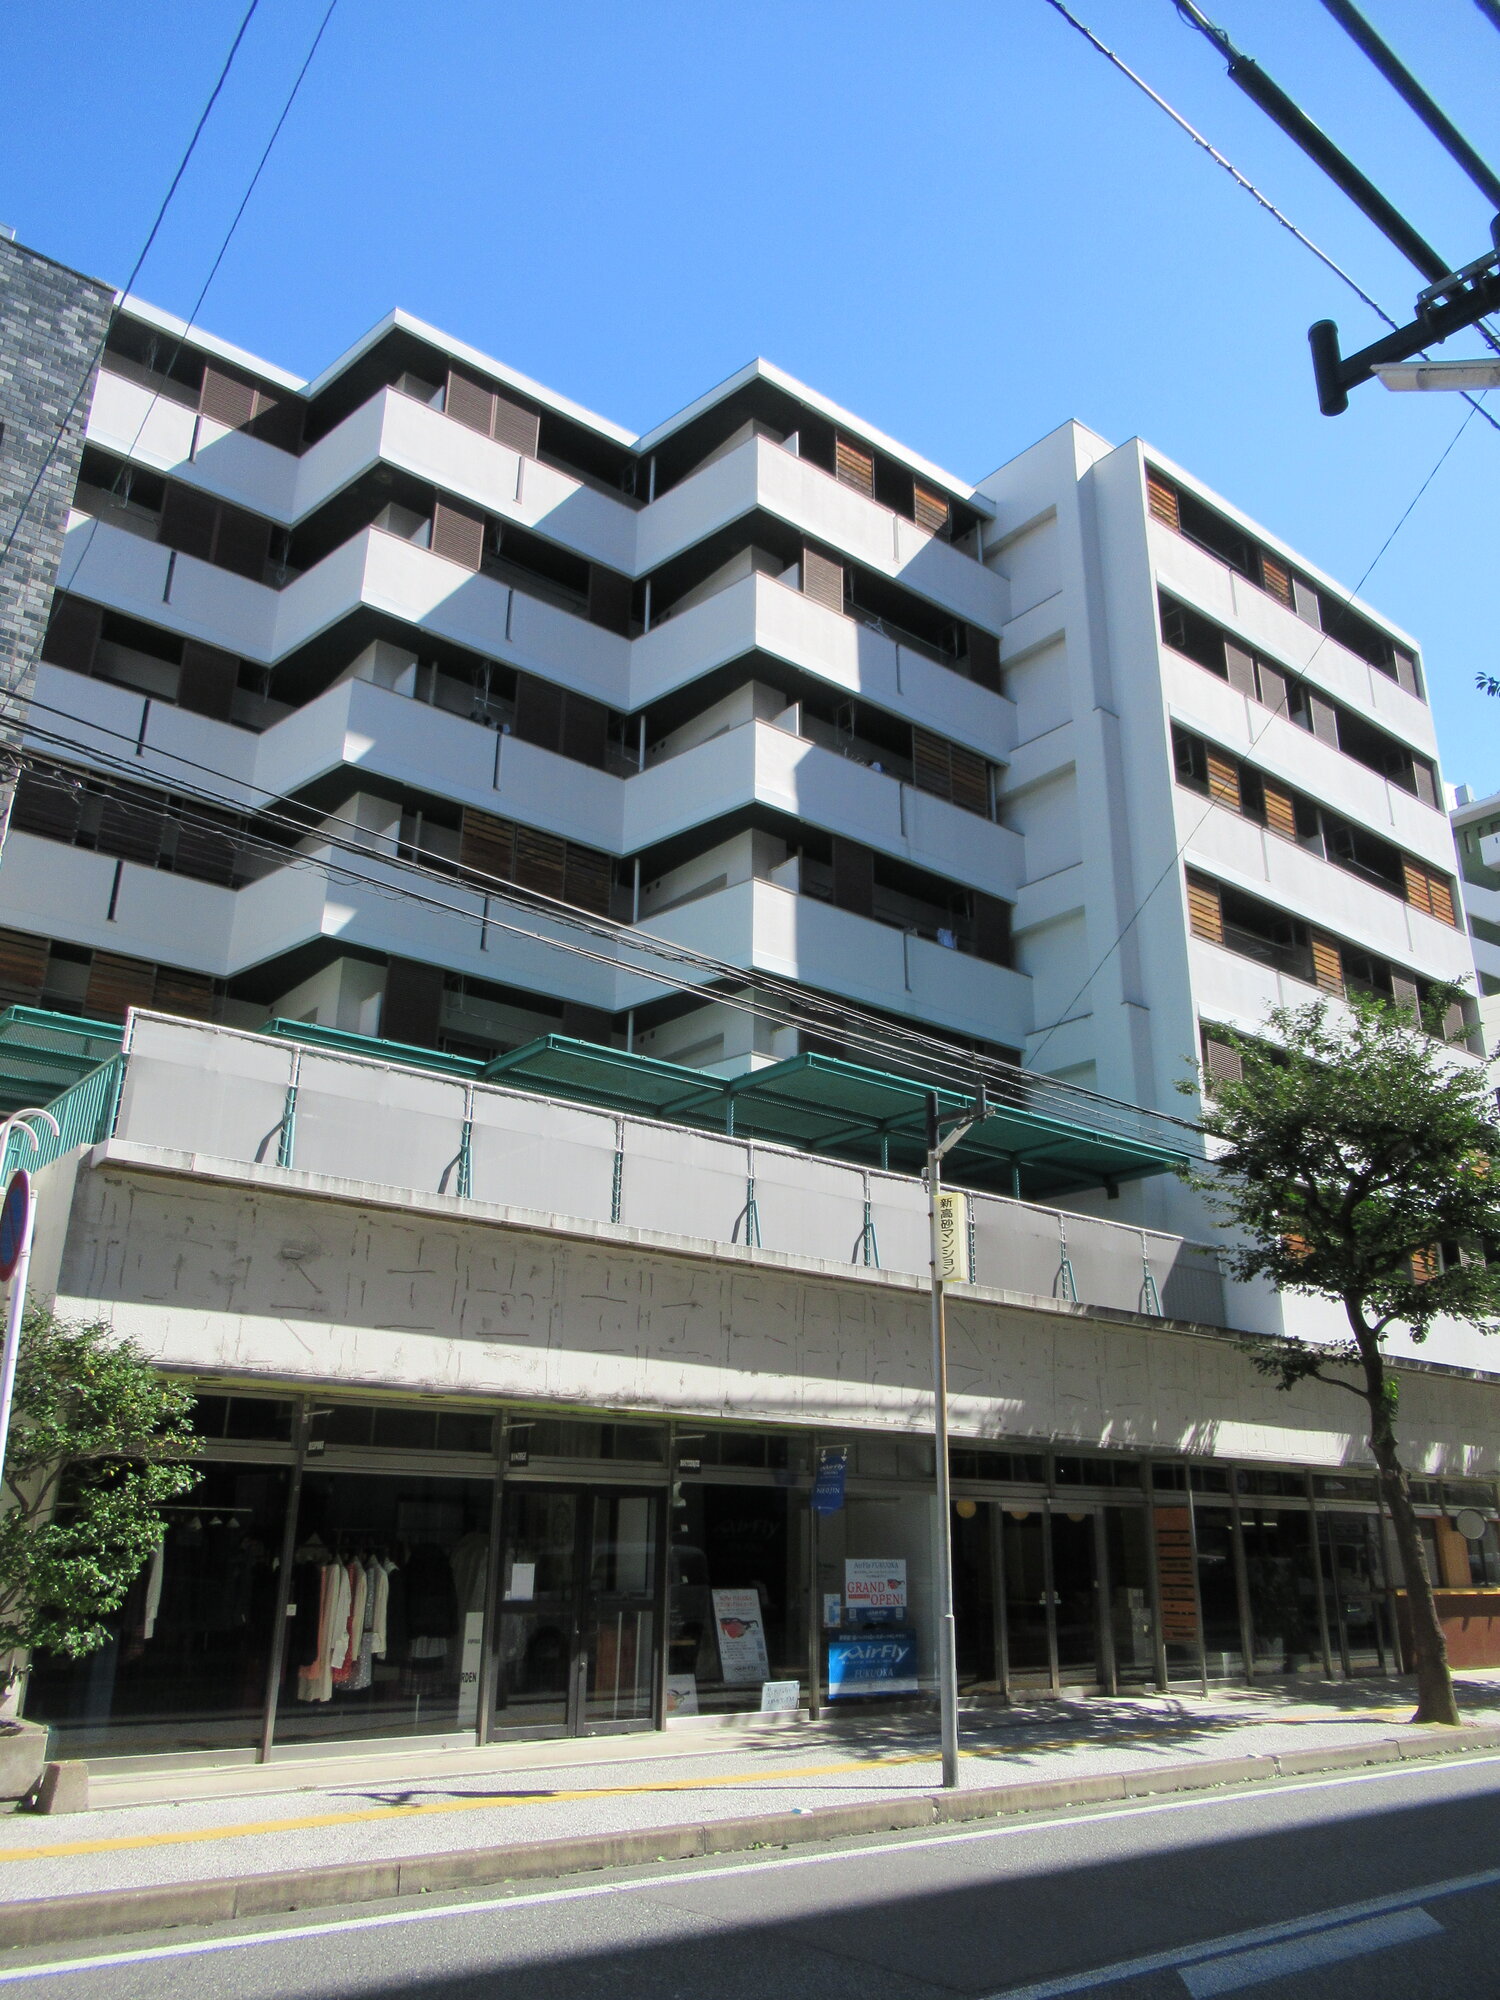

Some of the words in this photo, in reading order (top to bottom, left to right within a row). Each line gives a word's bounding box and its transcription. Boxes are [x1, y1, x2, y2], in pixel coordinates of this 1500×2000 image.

[939, 1197, 956, 1277] 新高砂マンション
[847, 1581, 886, 1593] GRAND
[870, 1593, 904, 1606] OPEN!
[838, 1644, 910, 1663] AirFly
[854, 1668, 894, 1679] FUKUOKA
